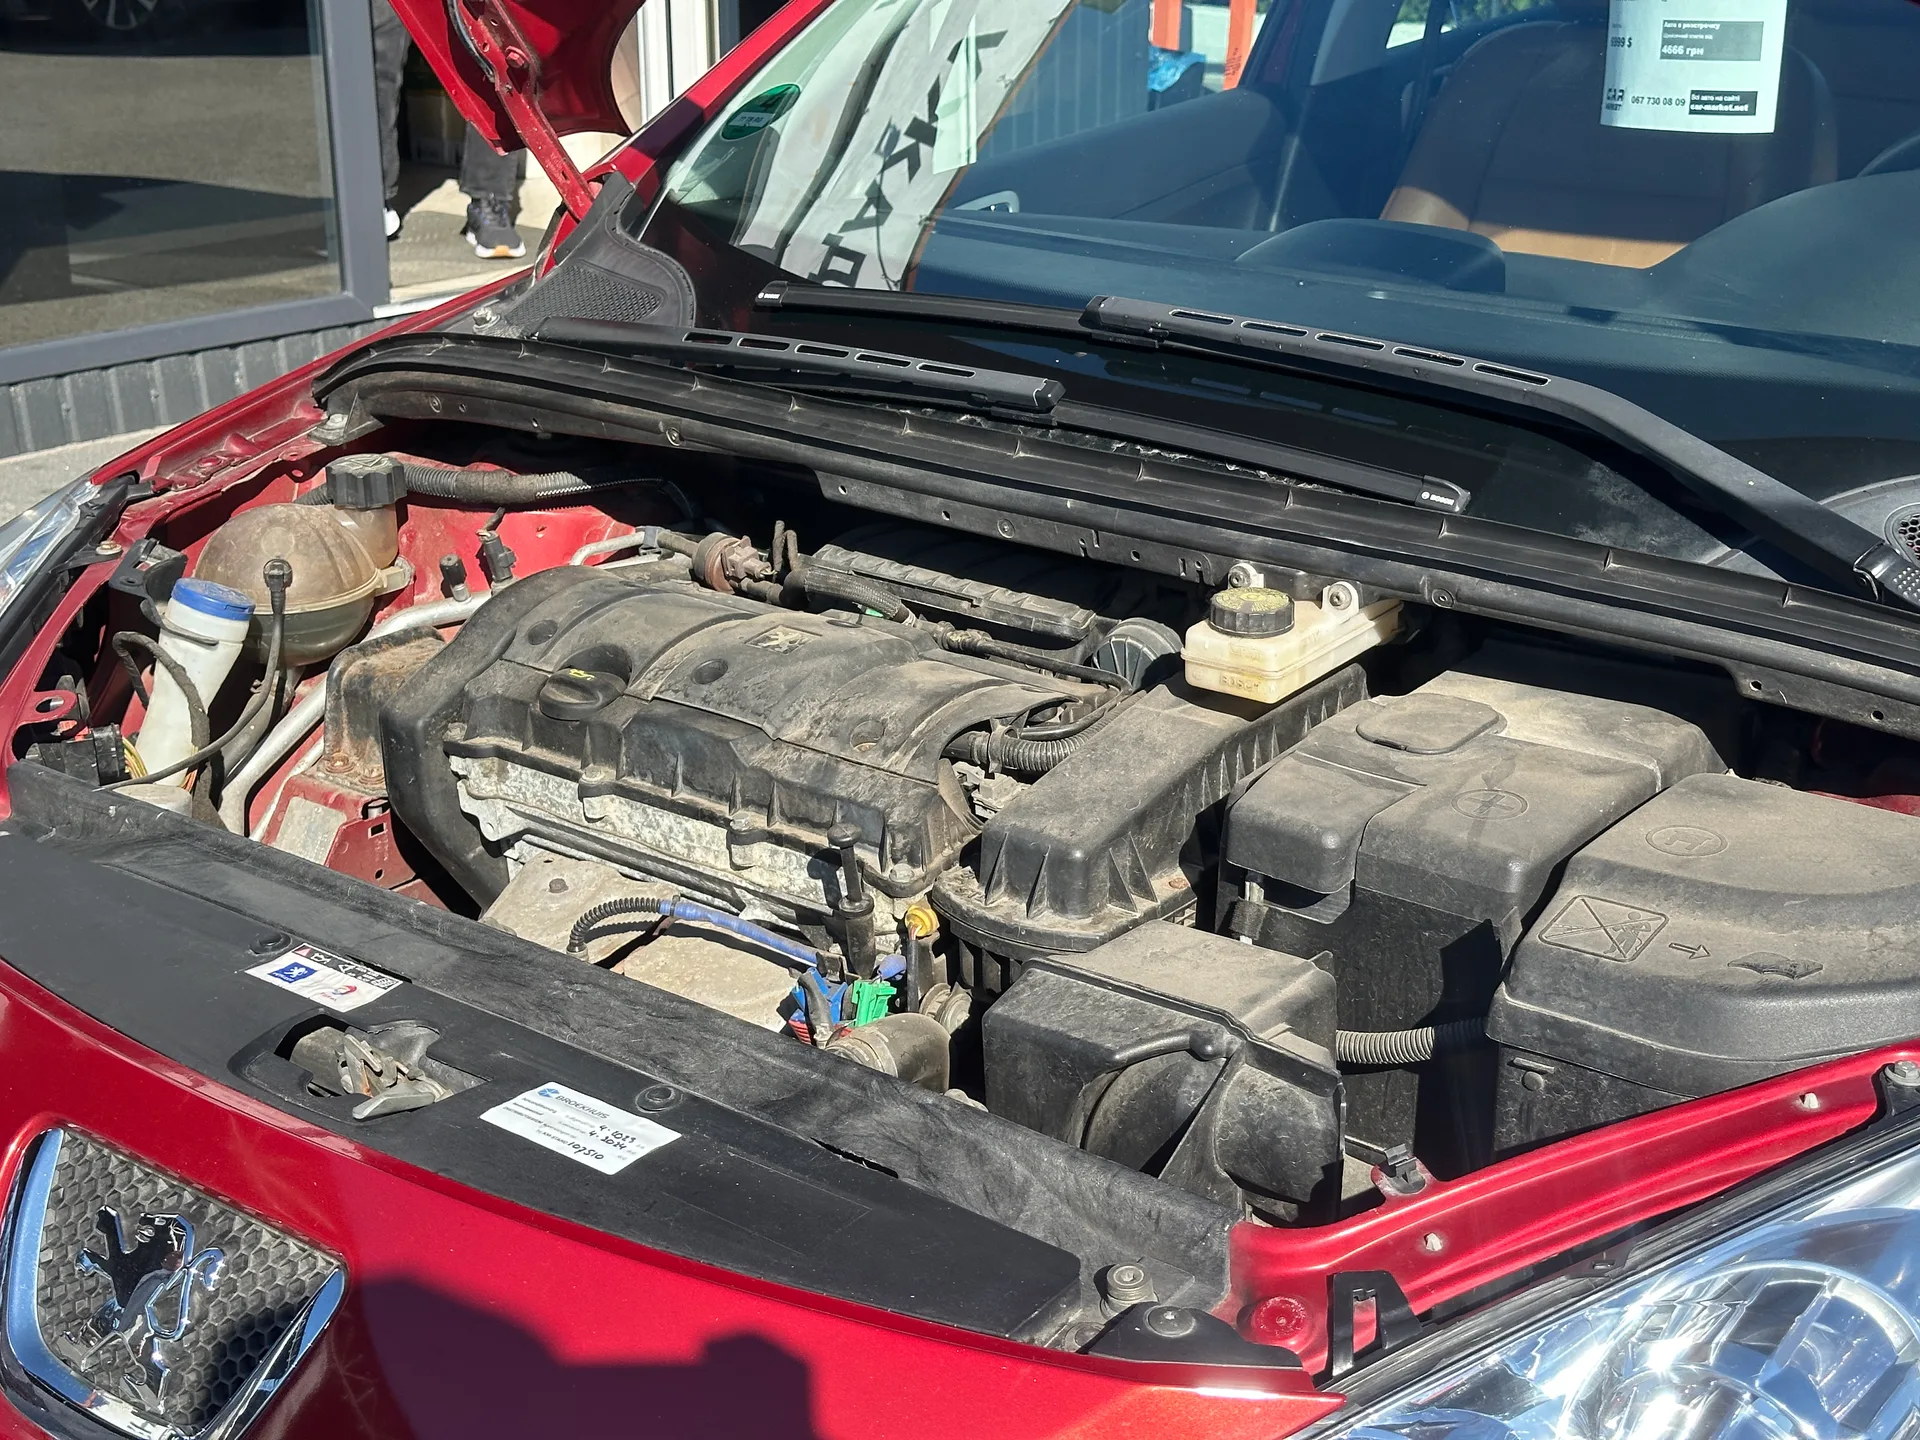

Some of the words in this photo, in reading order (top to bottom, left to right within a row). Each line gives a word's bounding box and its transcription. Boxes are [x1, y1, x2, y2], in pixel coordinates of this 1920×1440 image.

[1661, 45, 1684, 55] 4666
[1686, 47, 1704, 57] грн
[1631, 95, 1644, 105] 067
[1646, 96, 1661, 105] 730
[1662, 97, 1673, 106] 08
[1675, 97, 1686, 106] 09
[555, 1095, 610, 1119] BROEKHUIS
